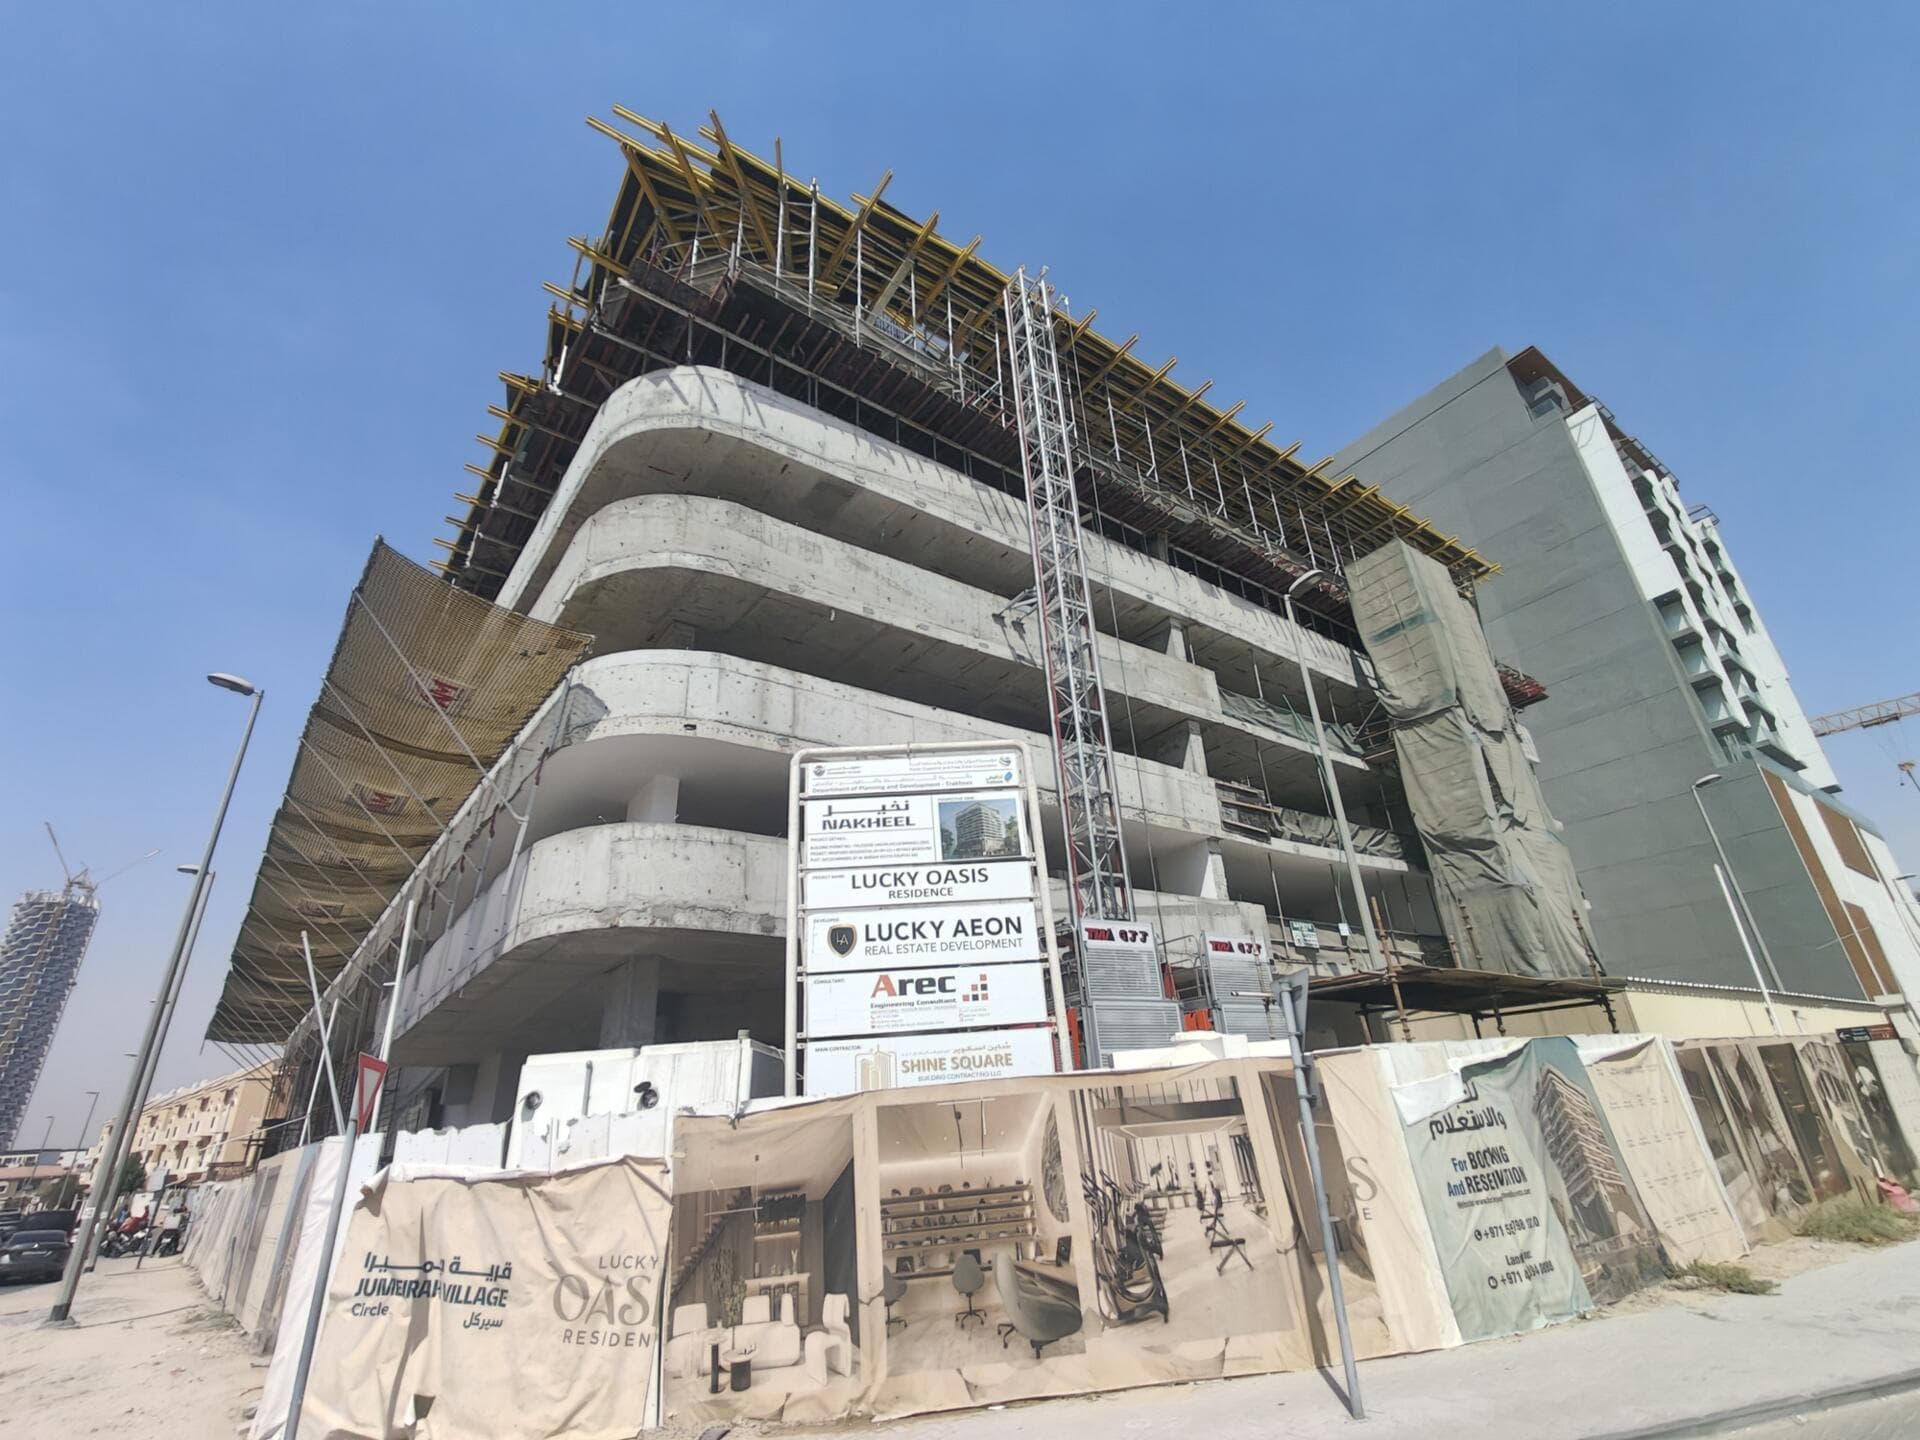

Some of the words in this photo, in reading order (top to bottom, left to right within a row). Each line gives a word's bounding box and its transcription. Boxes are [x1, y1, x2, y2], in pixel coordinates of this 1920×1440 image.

[822, 816, 916, 830] NAKHEEL
[852, 871, 919, 890] LUCKY
[926, 868, 989, 886] OASIS
[888, 887, 954, 900] RESIDENCE
[865, 920, 945, 942] LUCKY
[953, 916, 1023, 938] AEON
[865, 944, 893, 956] REAL
[896, 942, 937, 954] ESTATE
[940, 938, 1023, 952] DEVELOPMENT
[870, 974, 956, 998] Arec
[901, 1057, 947, 1073] SHINE
[950, 1053, 1013, 1071] SQUARE
[1451, 1157, 1468, 1172] For
[1447, 1180, 1466, 1197] And
[598, 1255, 659, 1270] LUCKY
[442, 1283, 509, 1307] VILLAGE
[351, 1302, 389, 1317] Circle
[463, 1311, 504, 1330] سيركل
